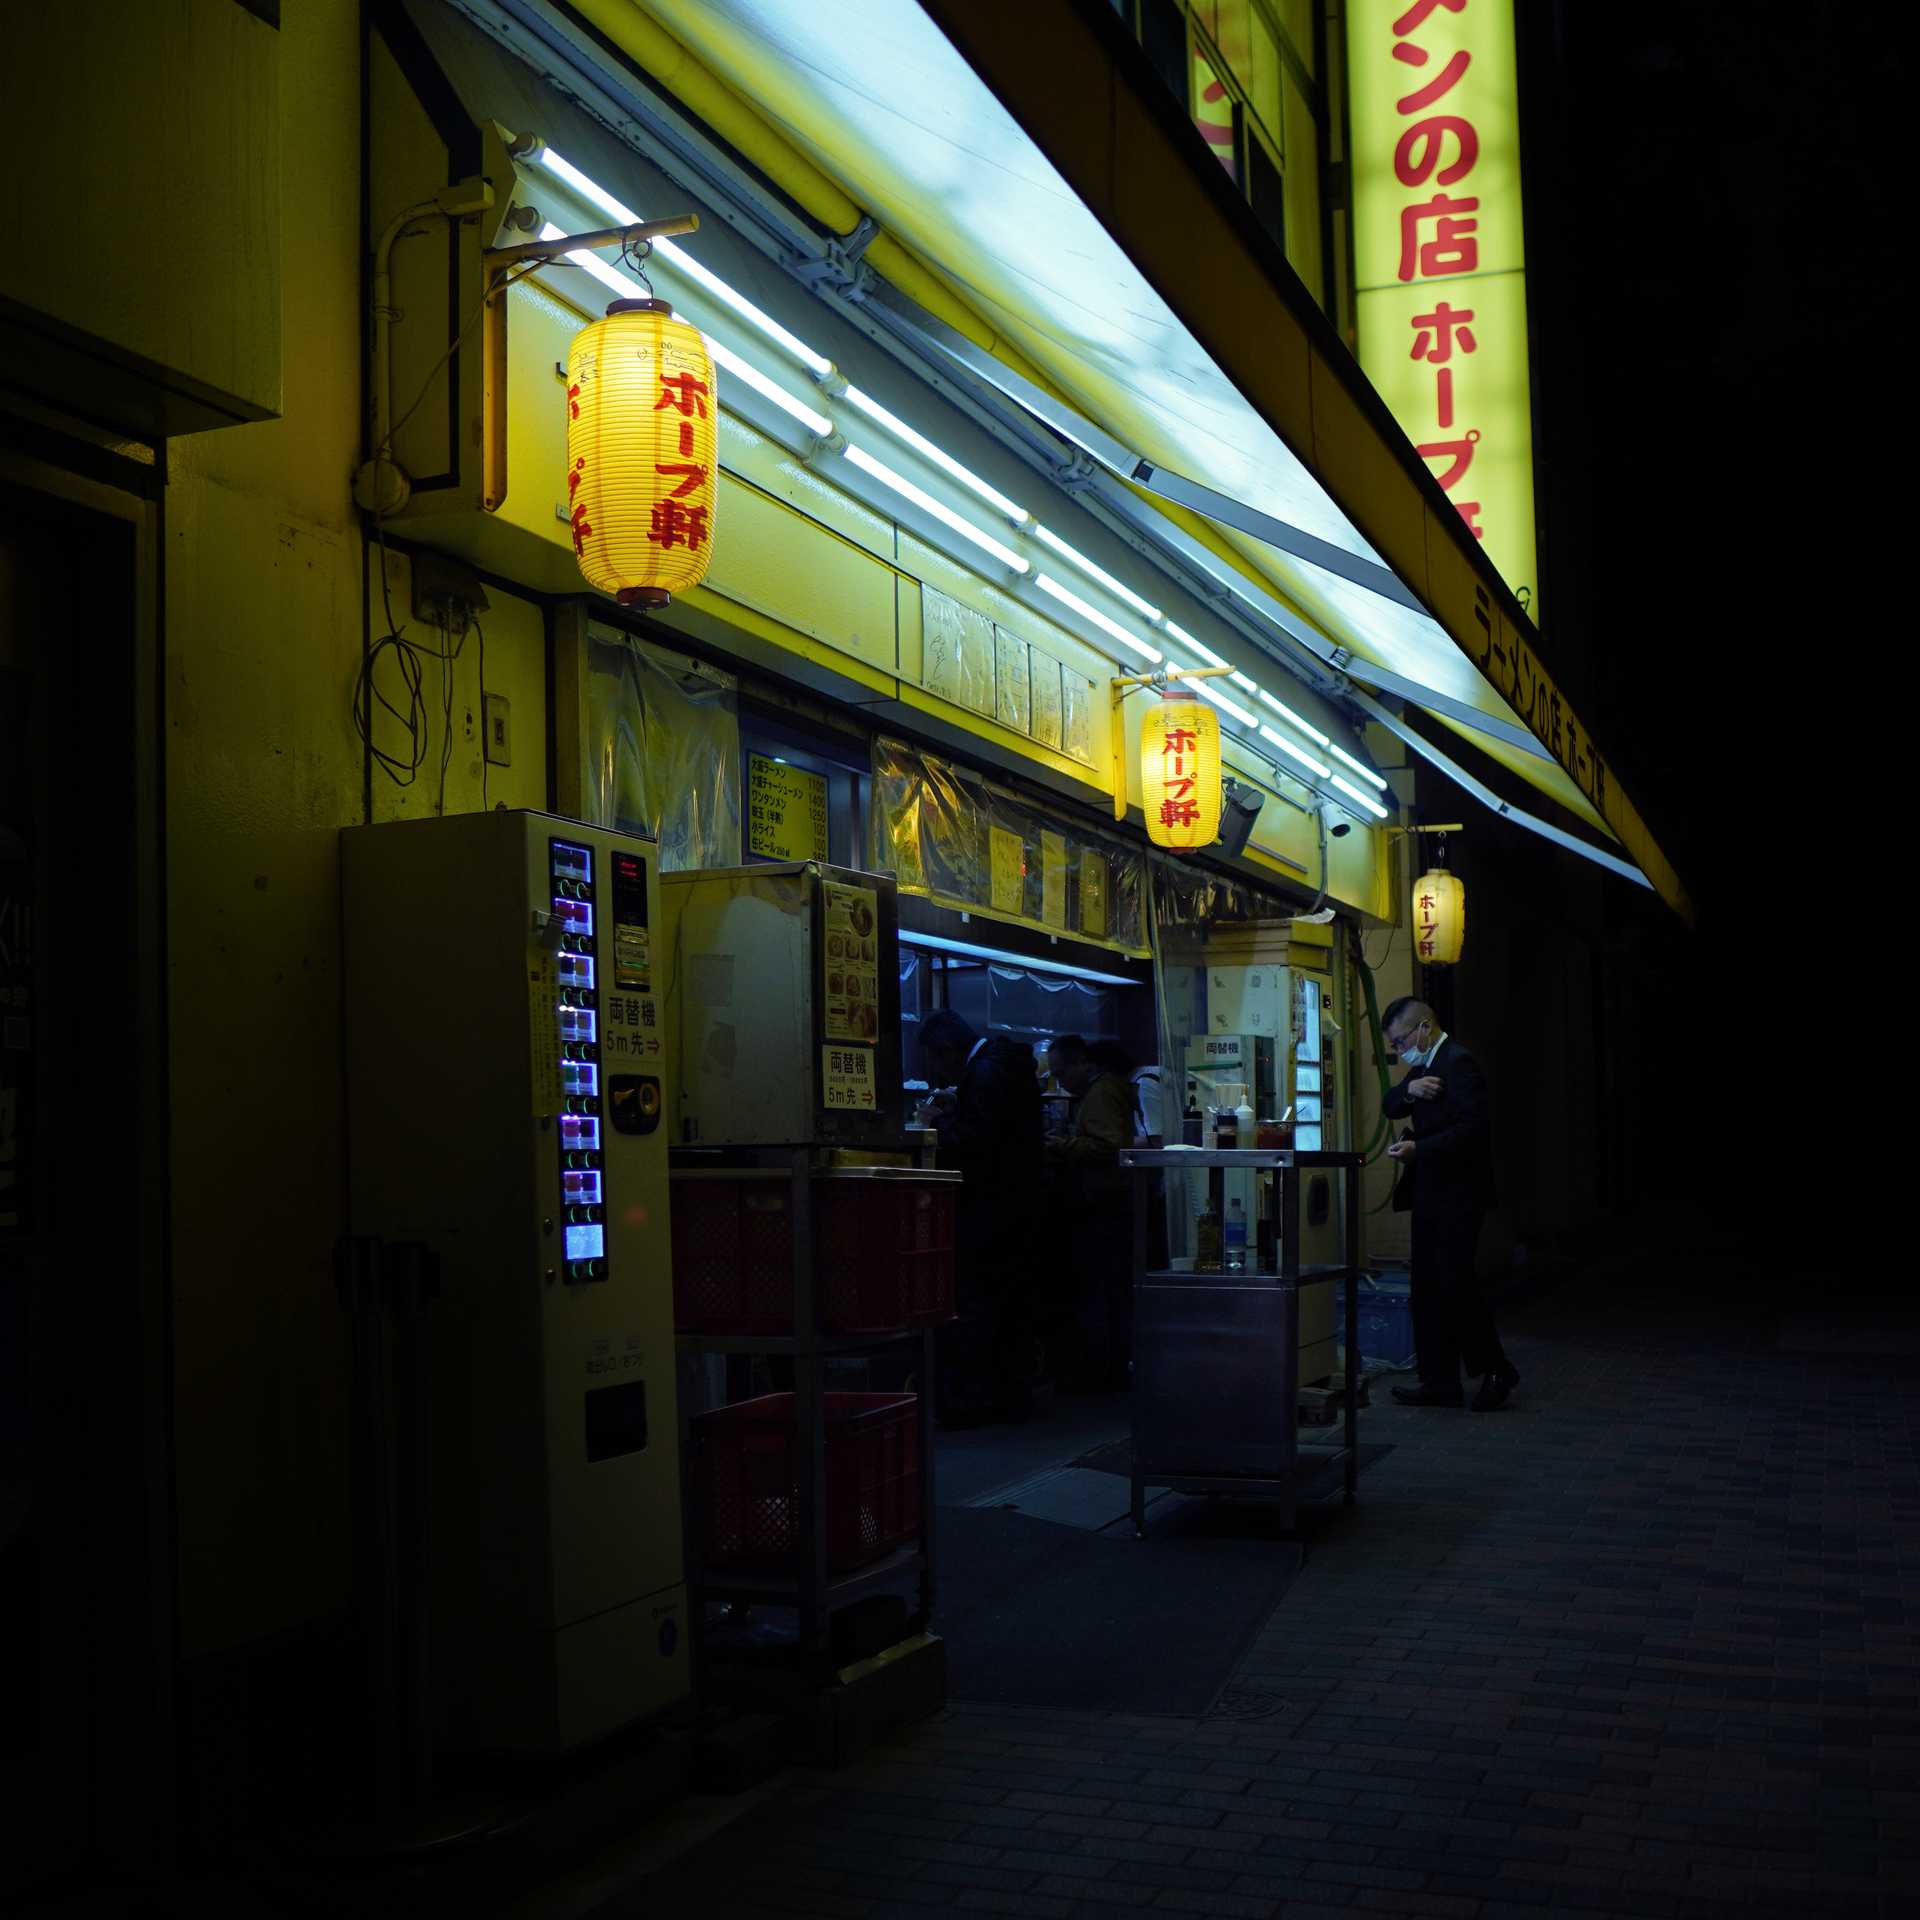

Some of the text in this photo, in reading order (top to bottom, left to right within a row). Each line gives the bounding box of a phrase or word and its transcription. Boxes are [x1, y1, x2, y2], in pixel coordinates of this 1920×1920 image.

[1411, 302, 1484, 540] ホープ
[646, 372, 708, 551] ホープ軒
[1475, 583, 1562, 764] ラーメンの店
[1160, 728, 1200, 828] ホープ軒
[1419, 894, 1439, 957] ホープ軒
[608, 996, 656, 1027] 両替機
[606, 1030, 644, 1055] 5m先
[830, 1051, 866, 1075] 両替機
[1207, 1042, 1239, 1055] 両替機
[828, 1087, 857, 1105] 5m先
